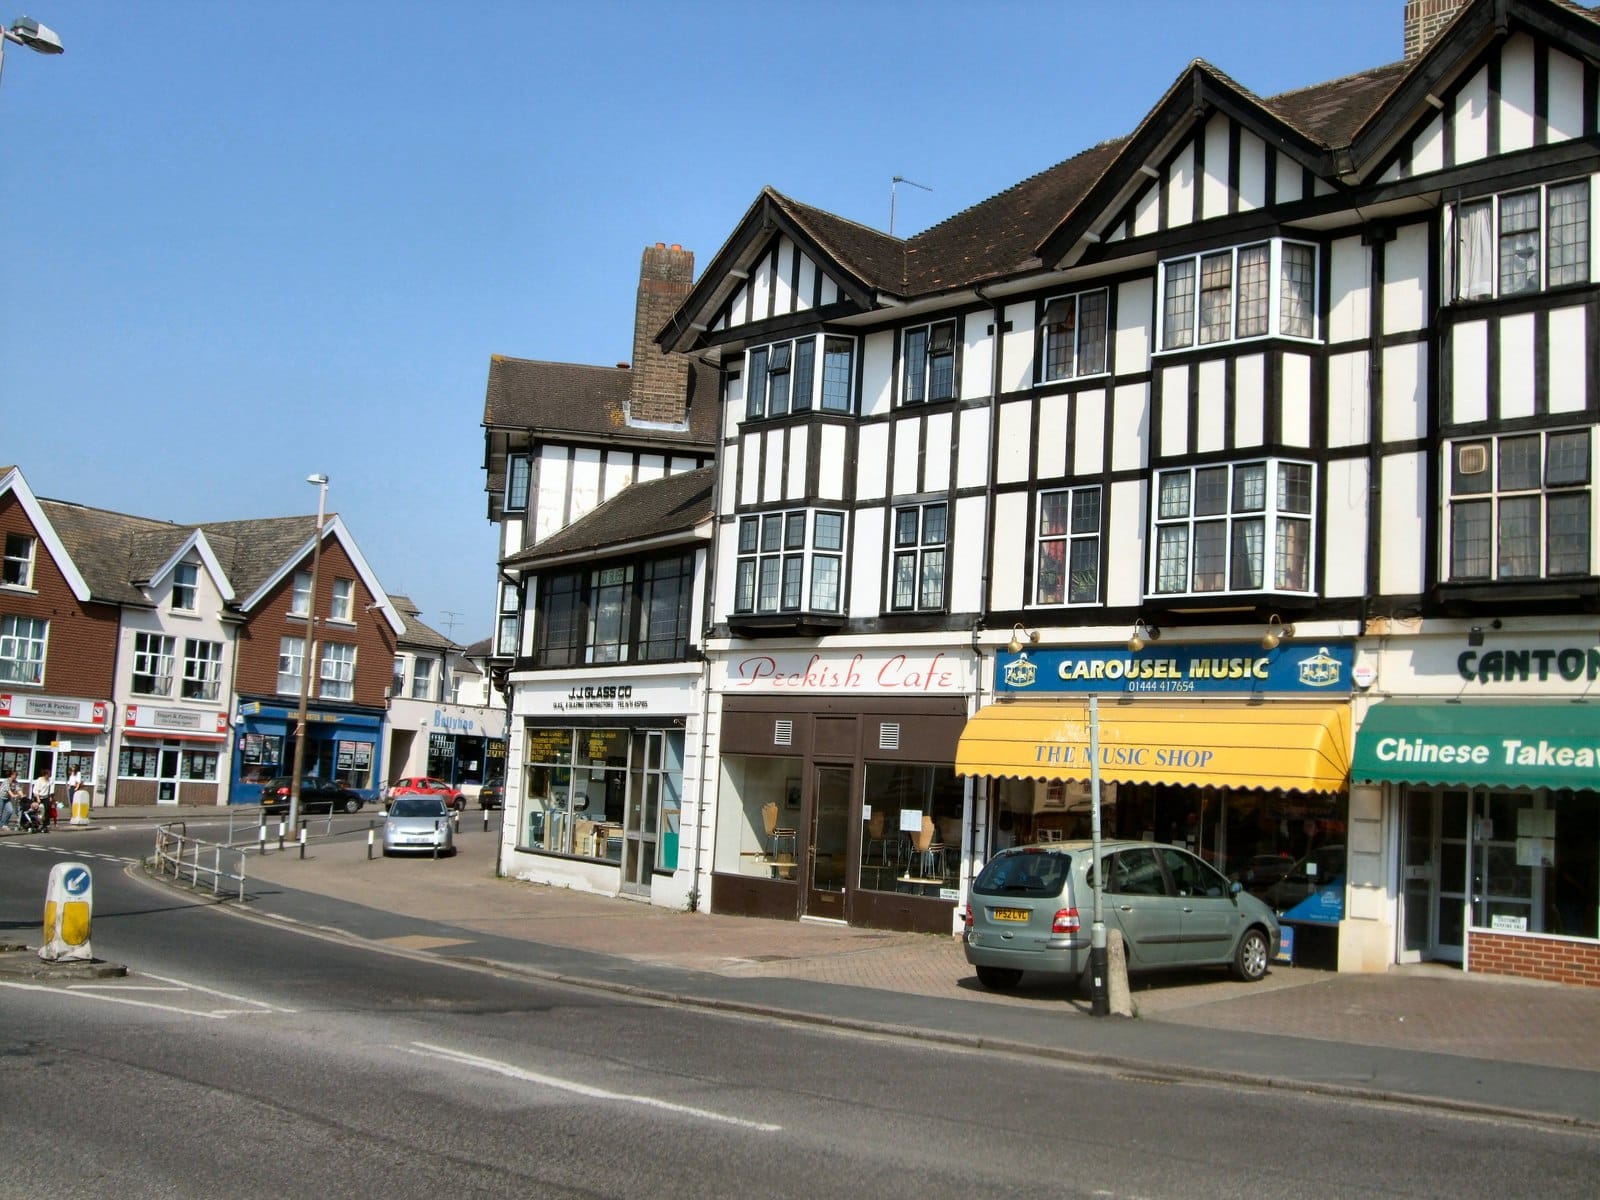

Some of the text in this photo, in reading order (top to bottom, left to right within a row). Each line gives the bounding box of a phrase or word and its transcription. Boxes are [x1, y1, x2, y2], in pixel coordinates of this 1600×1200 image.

[736, 652, 952, 691] Peckish Cafe
[1058, 657, 1269, 680] CAROUSEL MUSIC
[585, 686, 617, 699] GLASS
[618, 685, 632, 698] CO
[1129, 681, 1195, 692] 01444 417654
[1034, 745, 1076, 763] THE
[1155, 749, 1213, 768] SHOP
[1376, 738, 1600, 768] Chinese Takea
